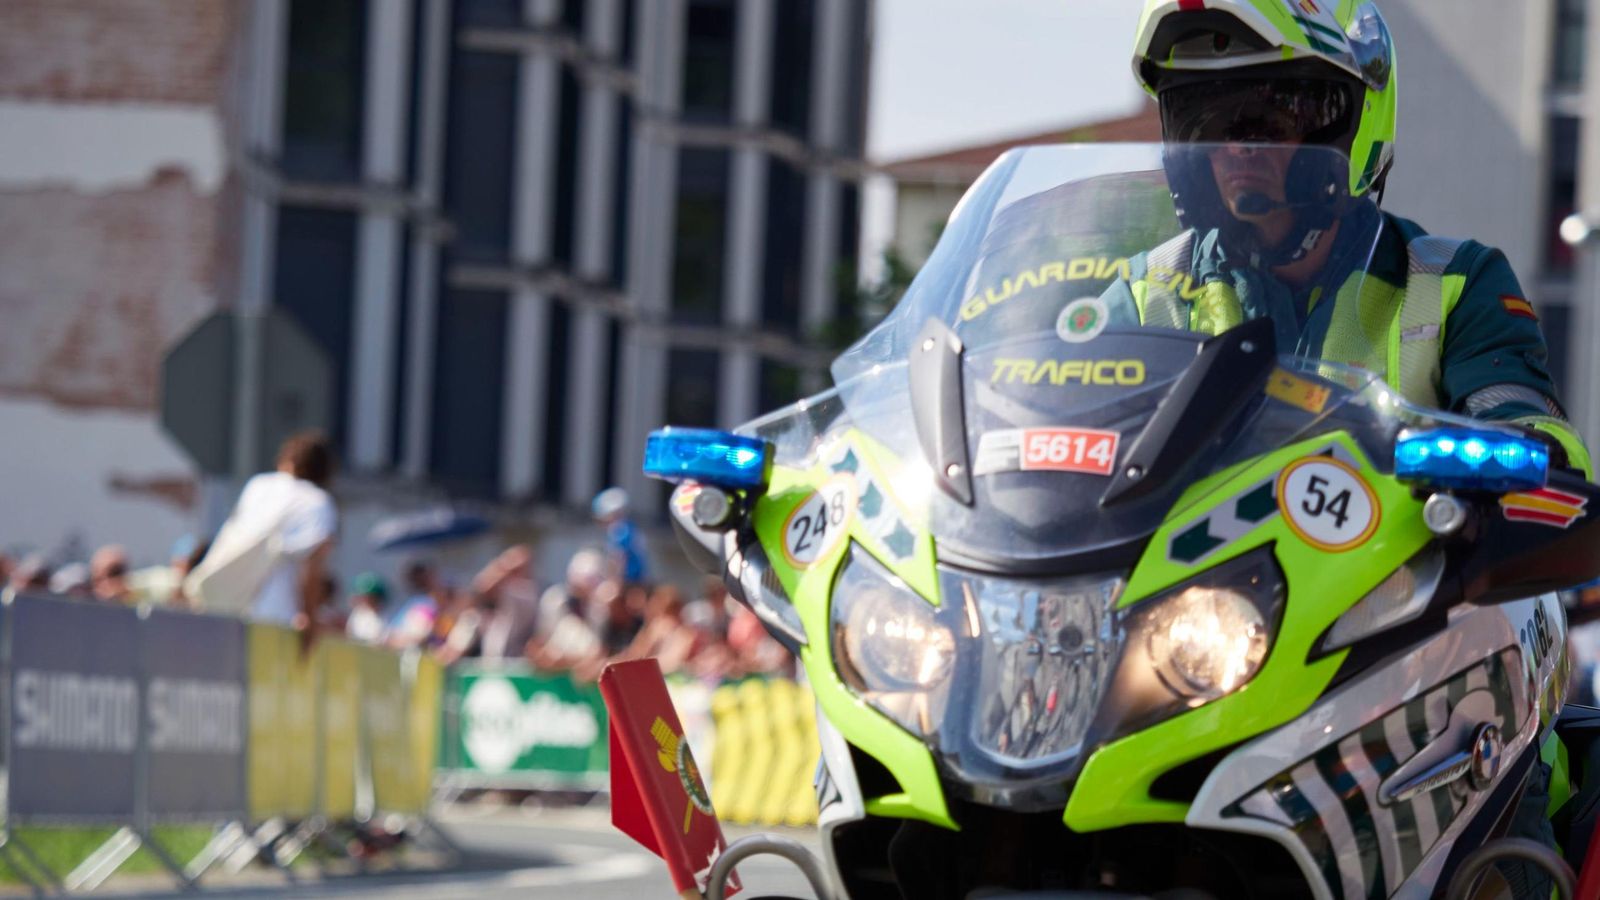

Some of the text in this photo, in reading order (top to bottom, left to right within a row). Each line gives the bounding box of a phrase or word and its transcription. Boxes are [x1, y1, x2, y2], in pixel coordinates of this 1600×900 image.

[960, 257, 1130, 321] GUARDIA
[990, 358, 1146, 386] TRAFICO
[1026, 434, 1112, 467] 5614
[792, 490, 845, 555] 248
[1302, 474, 1352, 530] 54
